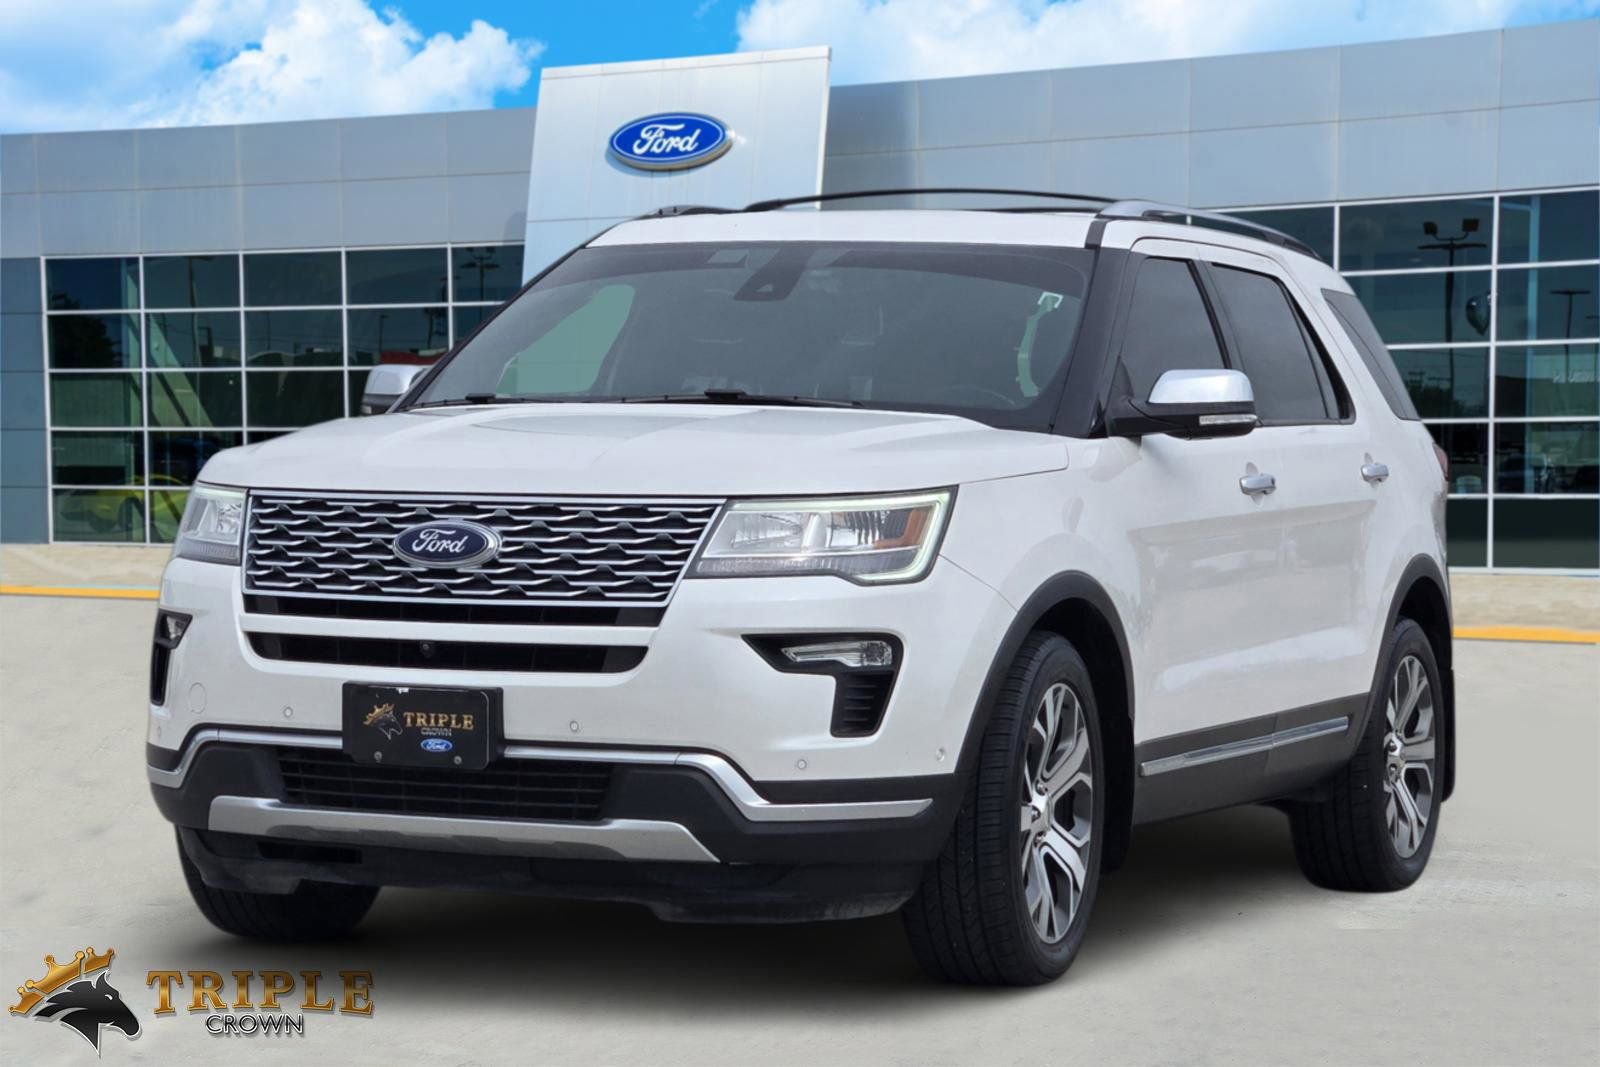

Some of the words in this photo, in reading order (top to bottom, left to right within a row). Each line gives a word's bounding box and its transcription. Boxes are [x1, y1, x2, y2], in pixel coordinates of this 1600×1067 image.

[633, 123, 701, 155] Ford
[412, 528, 469, 553] Ford
[403, 712, 474, 730] TRIPLE
